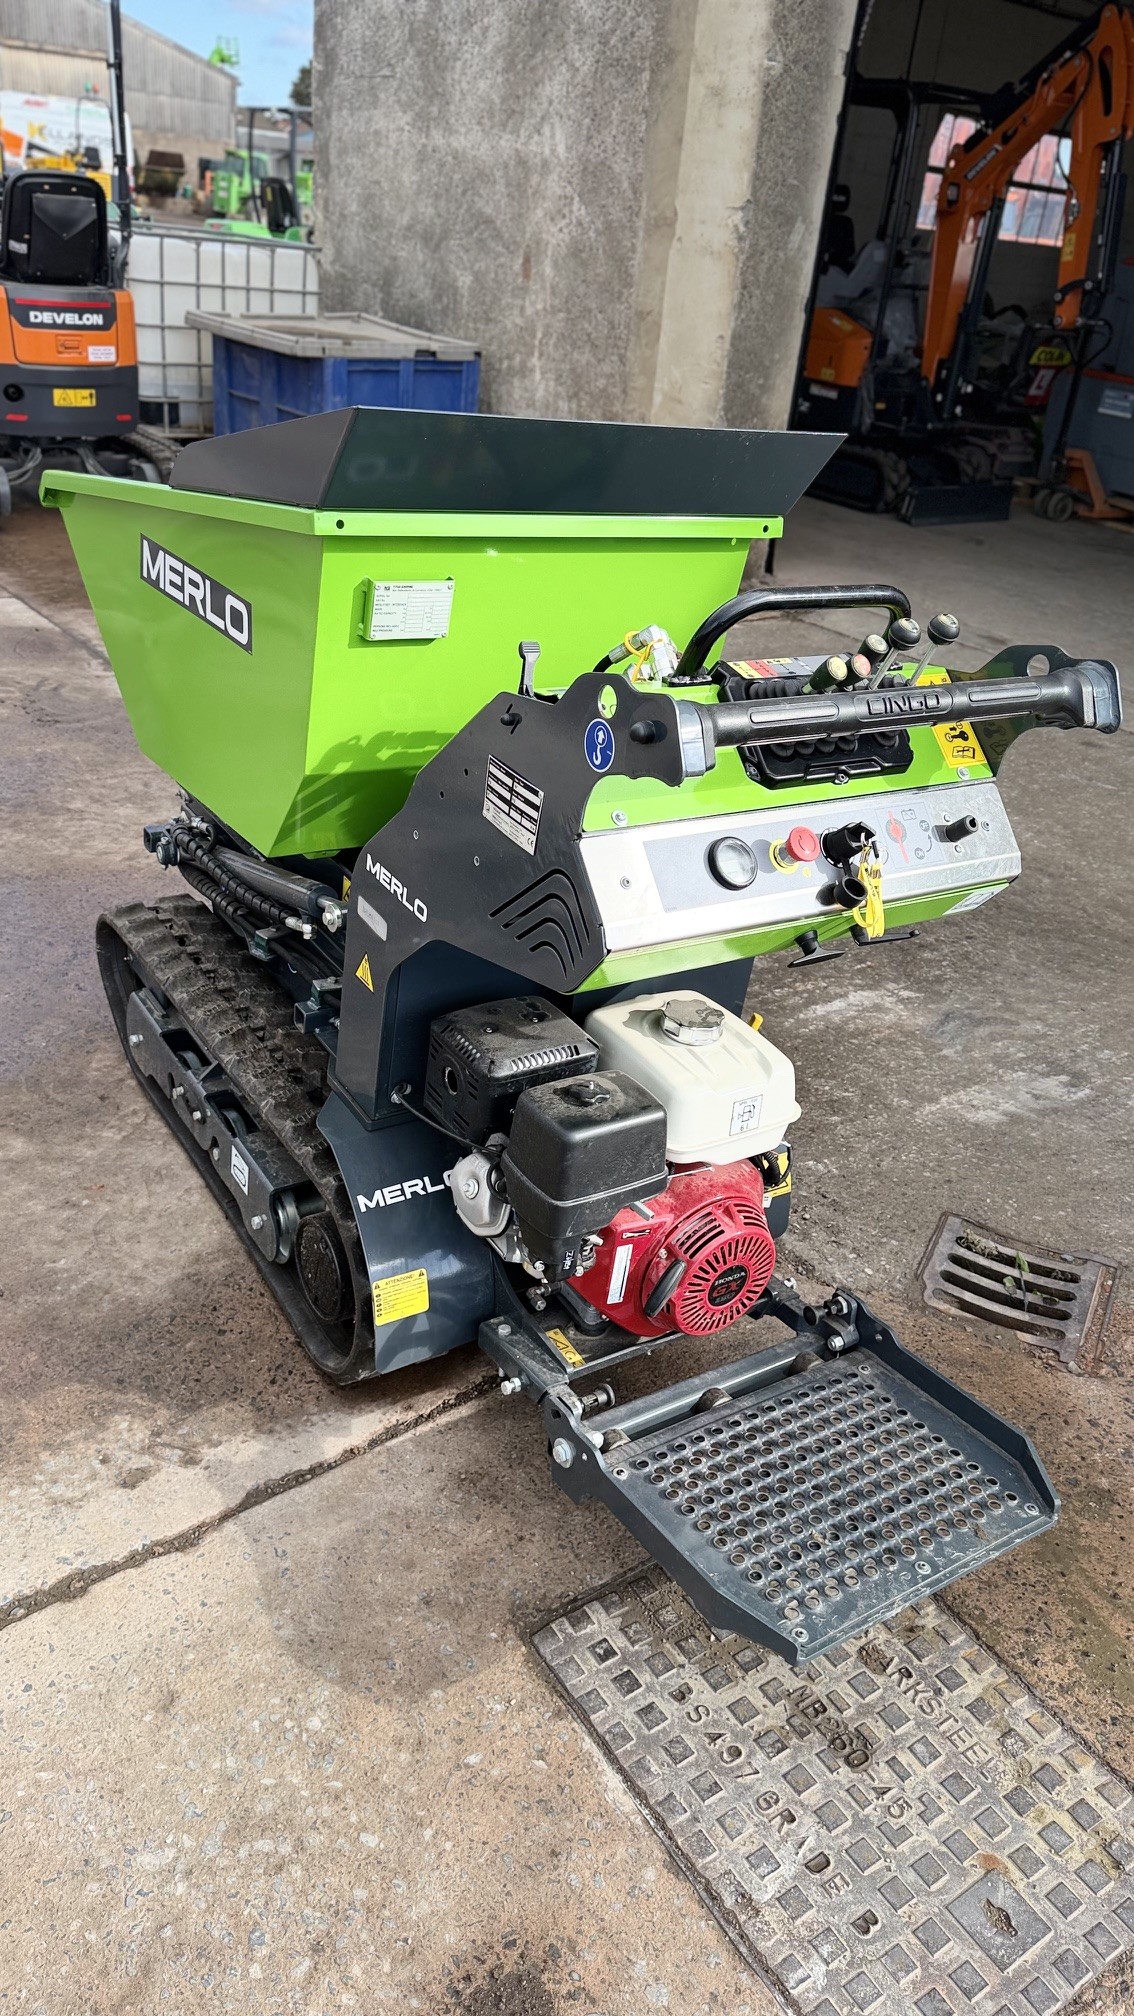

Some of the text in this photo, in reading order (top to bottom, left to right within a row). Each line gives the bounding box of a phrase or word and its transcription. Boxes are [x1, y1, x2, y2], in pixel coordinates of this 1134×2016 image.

[28, 310, 104, 326] DEVELON
[142, 539, 249, 645] MERLO
[867, 693, 941, 716] CINGO
[366, 853, 428, 923] MERLO
[712, 1279, 742, 1298] GX
[714, 1271, 746, 1286] HONDA
[755, 1790, 852, 1899] GRADE
[850, 1908, 879, 1937] B
